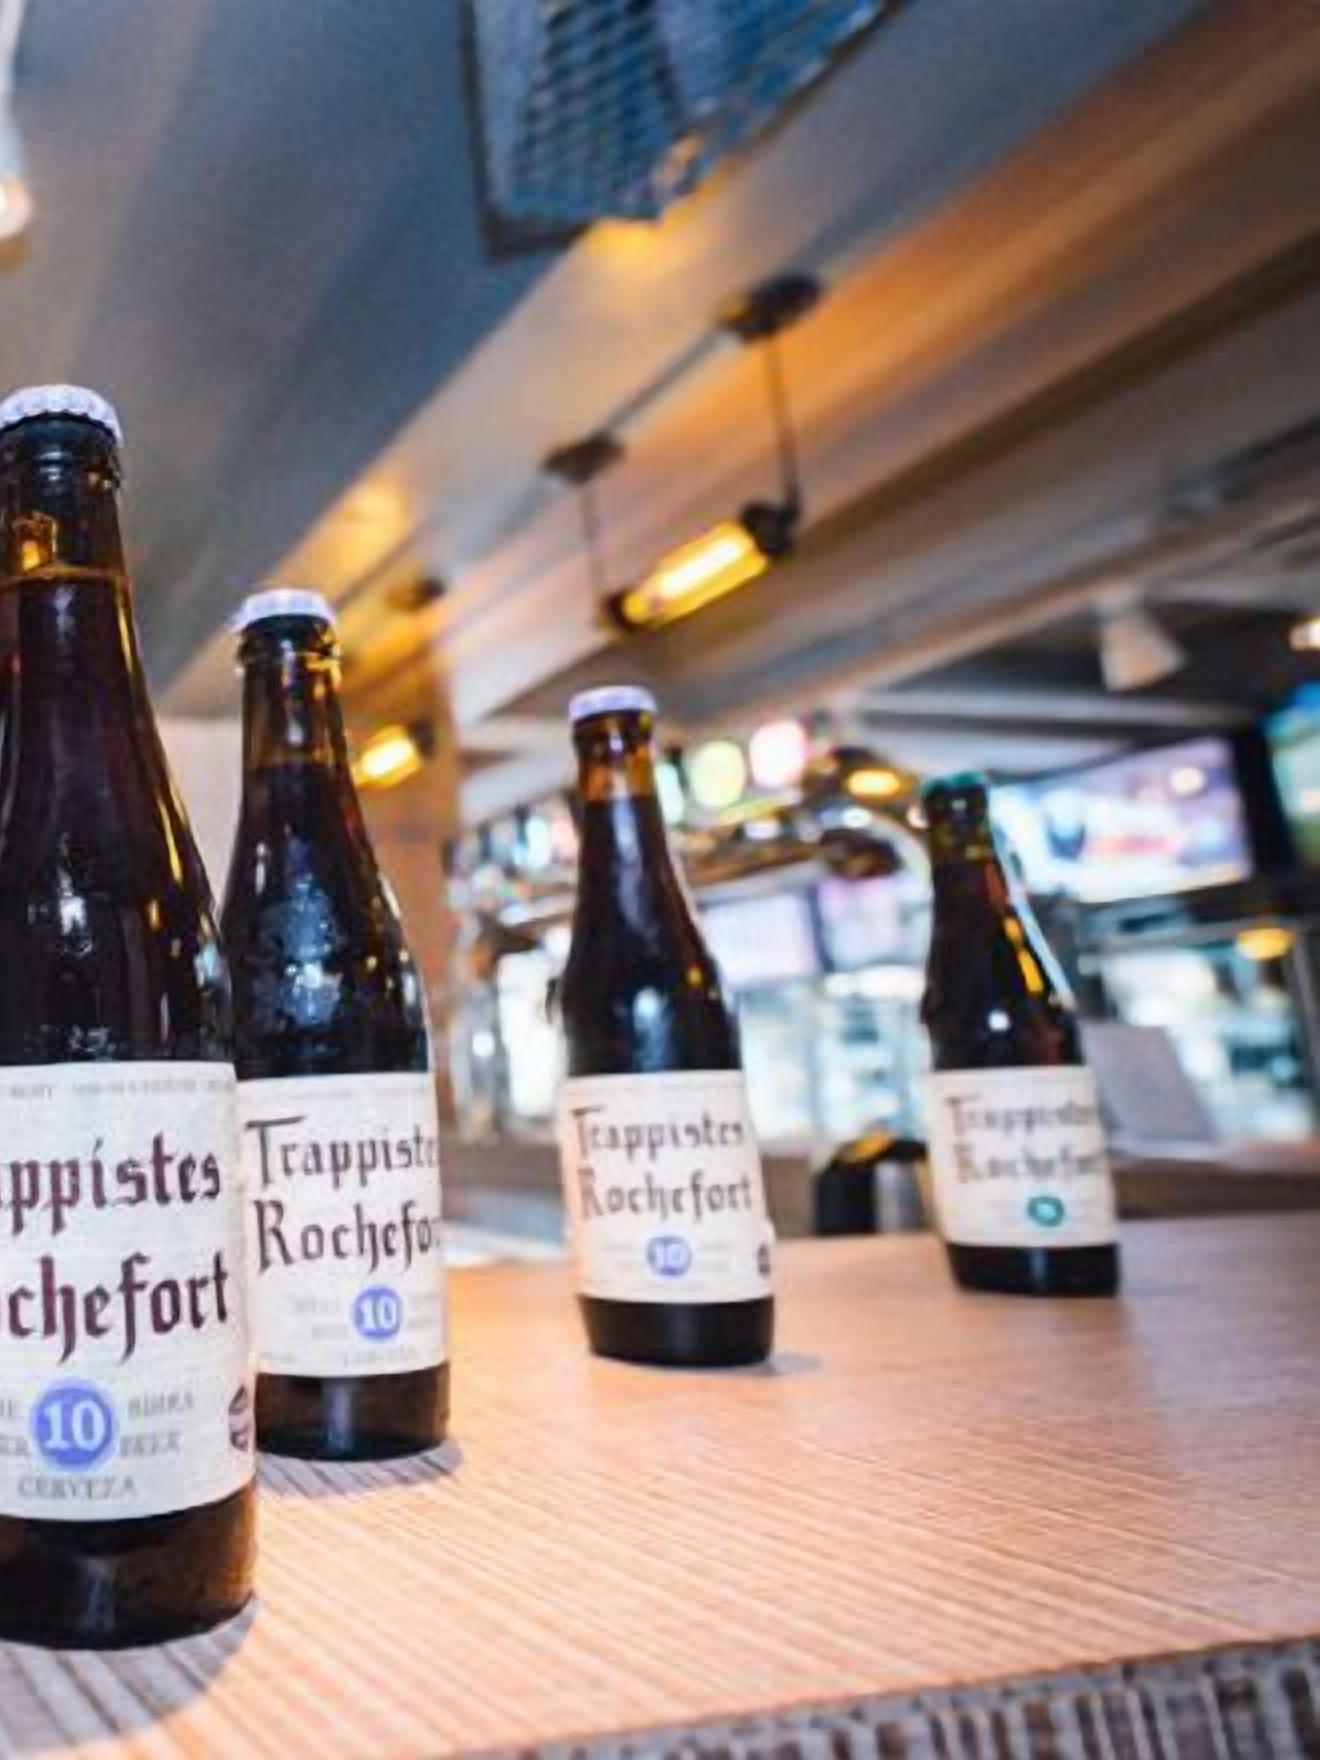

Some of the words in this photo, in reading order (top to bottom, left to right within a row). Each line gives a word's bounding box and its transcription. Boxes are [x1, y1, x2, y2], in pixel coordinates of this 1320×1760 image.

[572, 1106, 744, 1163] Trappistes
[577, 1168, 752, 1223] Rochefort
[360, 1295, 397, 1330] 10
[43, 1398, 107, 1450] 10
